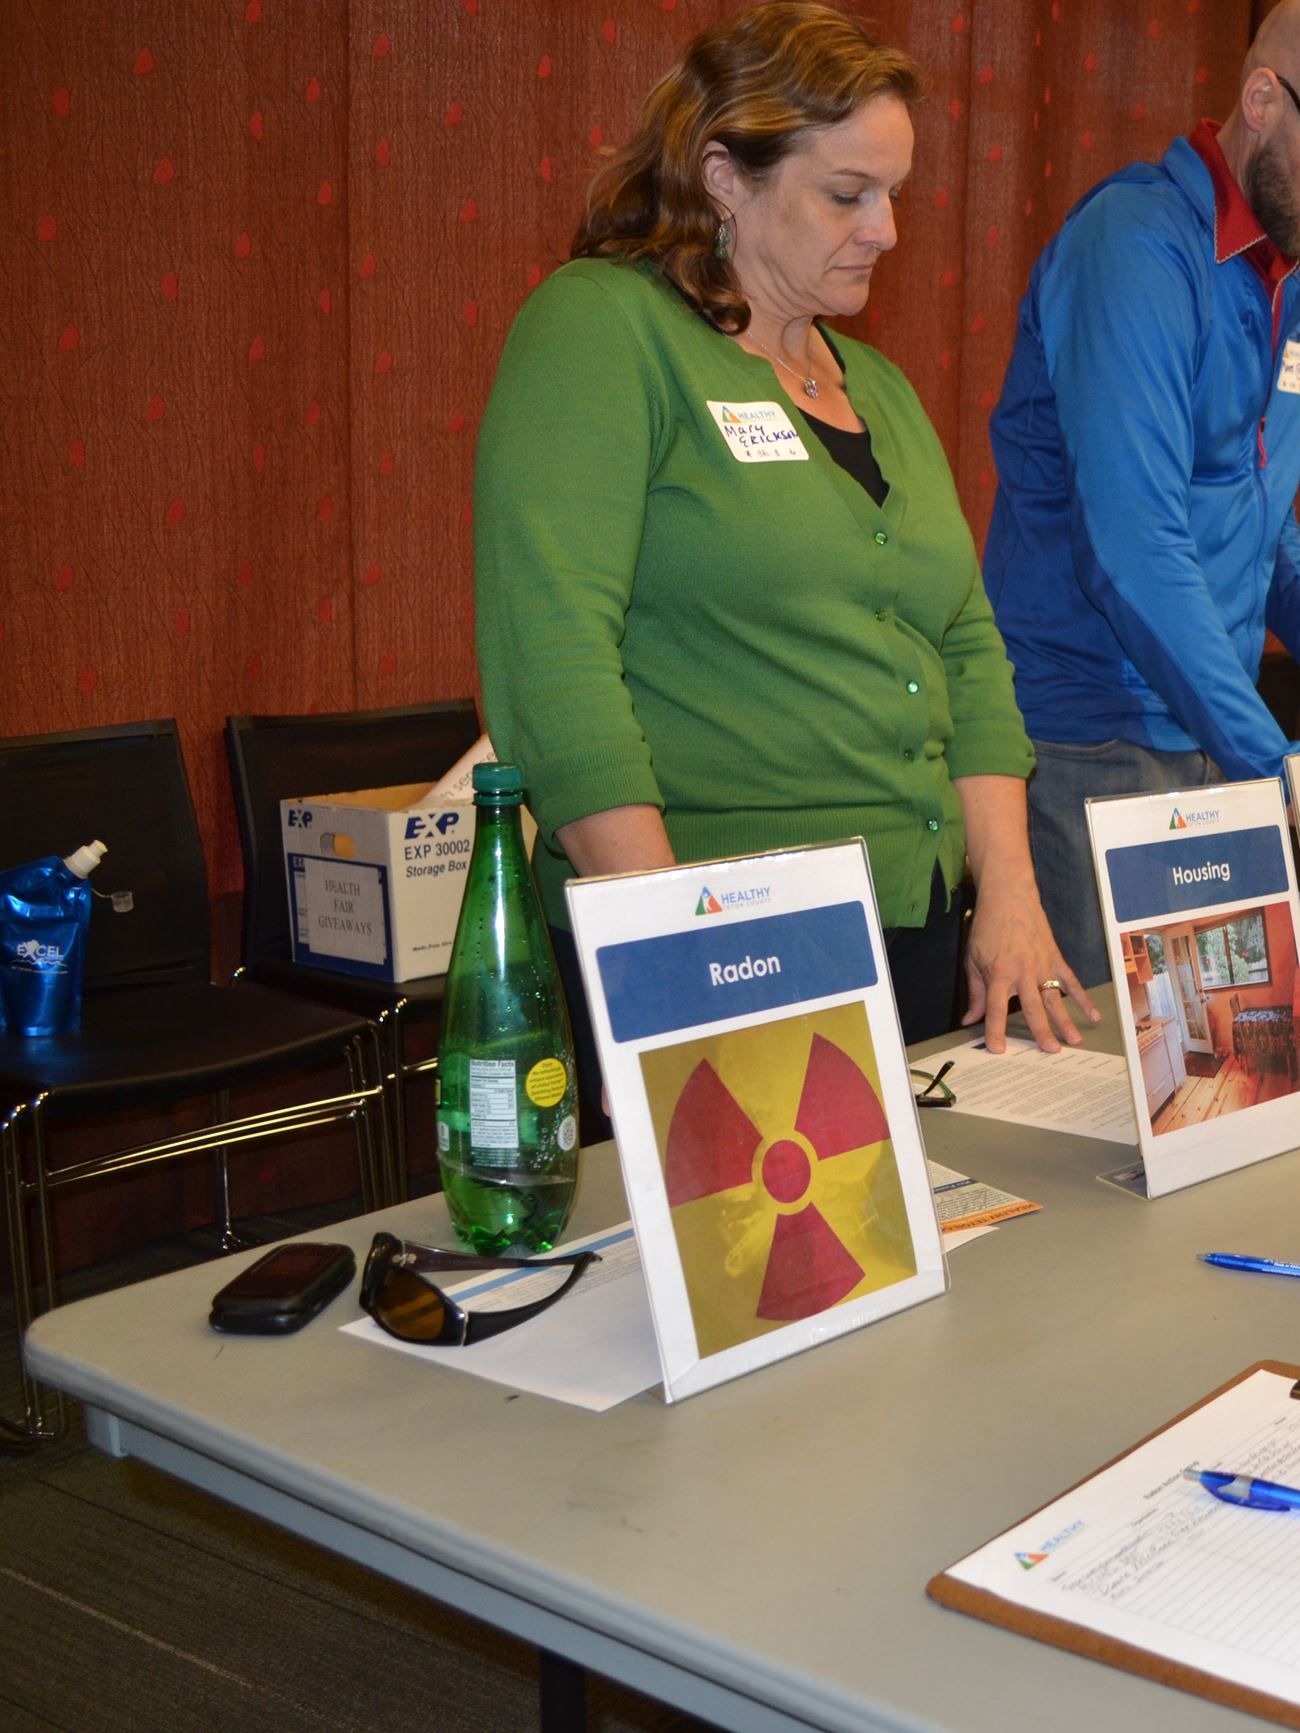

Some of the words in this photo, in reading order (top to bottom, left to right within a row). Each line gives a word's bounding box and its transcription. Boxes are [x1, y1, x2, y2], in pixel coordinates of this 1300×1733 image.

[737, 410, 776, 420] HEALTHY
[724, 424, 766, 438] Mary
[288, 810, 313, 829] EXP
[1185, 810, 1220, 822] HEALTHY
[404, 812, 460, 840] EXP
[404, 844, 432, 861] EXP
[435, 840, 471, 857] 30002
[406, 861, 446, 878] Storage
[448, 859, 468, 872] Box
[1172, 861, 1231, 886] Housing
[325, 879, 361, 897] HEALTH
[721, 886, 771, 905] HEALTHY
[333, 898, 354, 914] FAIR
[318, 915, 373, 936] GIVEAWAYS
[17, 942, 64, 960] EXCEL
[708, 955, 782, 987] Radon
[1038, 1519, 1085, 1552] HEALTHY
